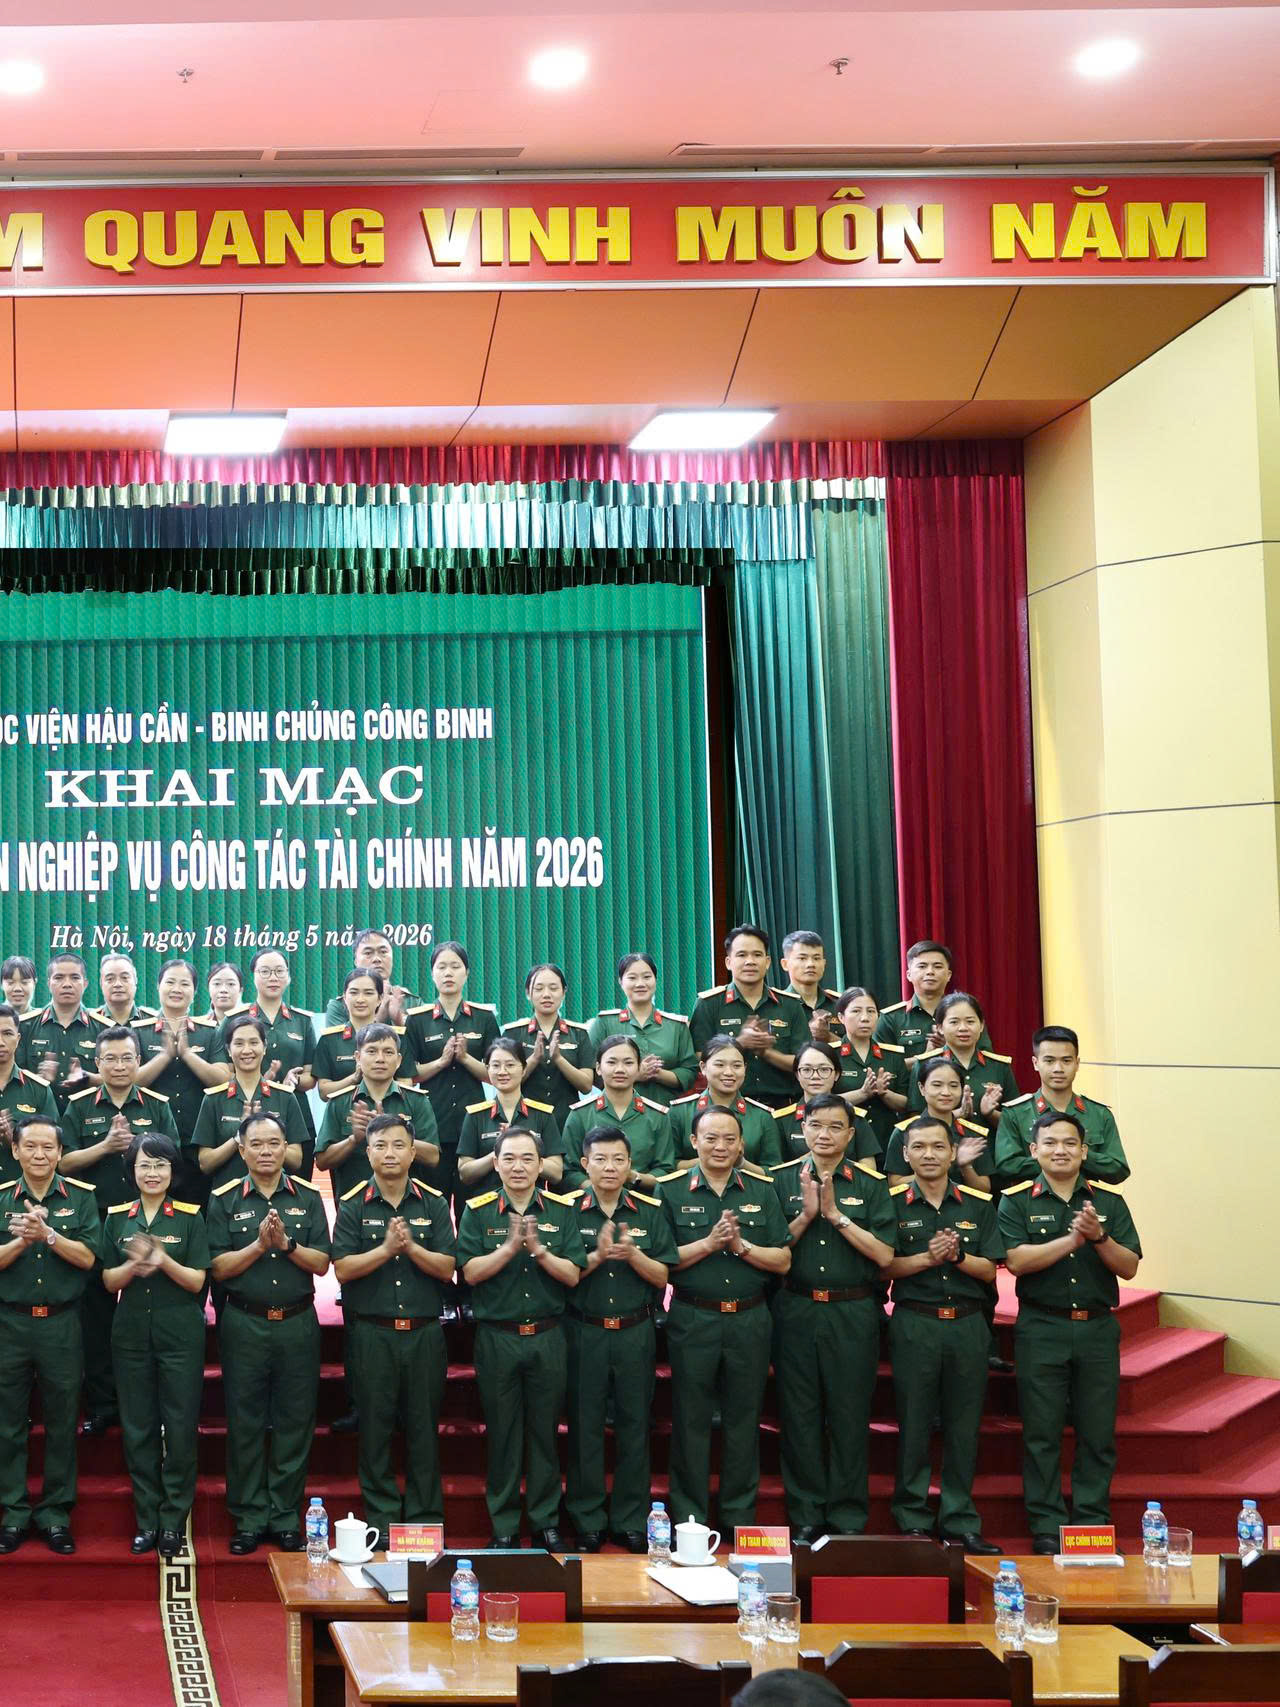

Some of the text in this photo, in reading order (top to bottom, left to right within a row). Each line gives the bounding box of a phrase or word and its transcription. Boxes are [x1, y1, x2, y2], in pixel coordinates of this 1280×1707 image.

[83, 208, 386, 274] QUANG
[422, 206, 632, 266] VINH
[675, 187, 945, 264] MUÔN
[991, 185, 1207, 262] NĂM
[25, 708, 79, 750] VIỆN
[86, 707, 132, 750] HẬU
[140, 702, 188, 744] CẦN
[212, 712, 268, 742] BINH
[275, 700, 356, 741] CHỦNG
[363, 703, 429, 740] CÔNG
[435, 708, 493, 739] BINH
[45, 765, 424, 816] KHAI MẠC
[19, 831, 118, 902] NGHIỆP
[127, 840, 162, 902] VỤ
[171, 829, 246, 890] CÔNG
[254, 828, 307, 889] TÁC
[315, 828, 358, 889] TÀI
[367, 827, 453, 889] CHÍNH
[462, 827, 527, 888] NĂM
[536, 836, 604, 888] 2026
[50, 924, 433, 954] Hà Nội, ngày 18 tháng 5 nă 2026
